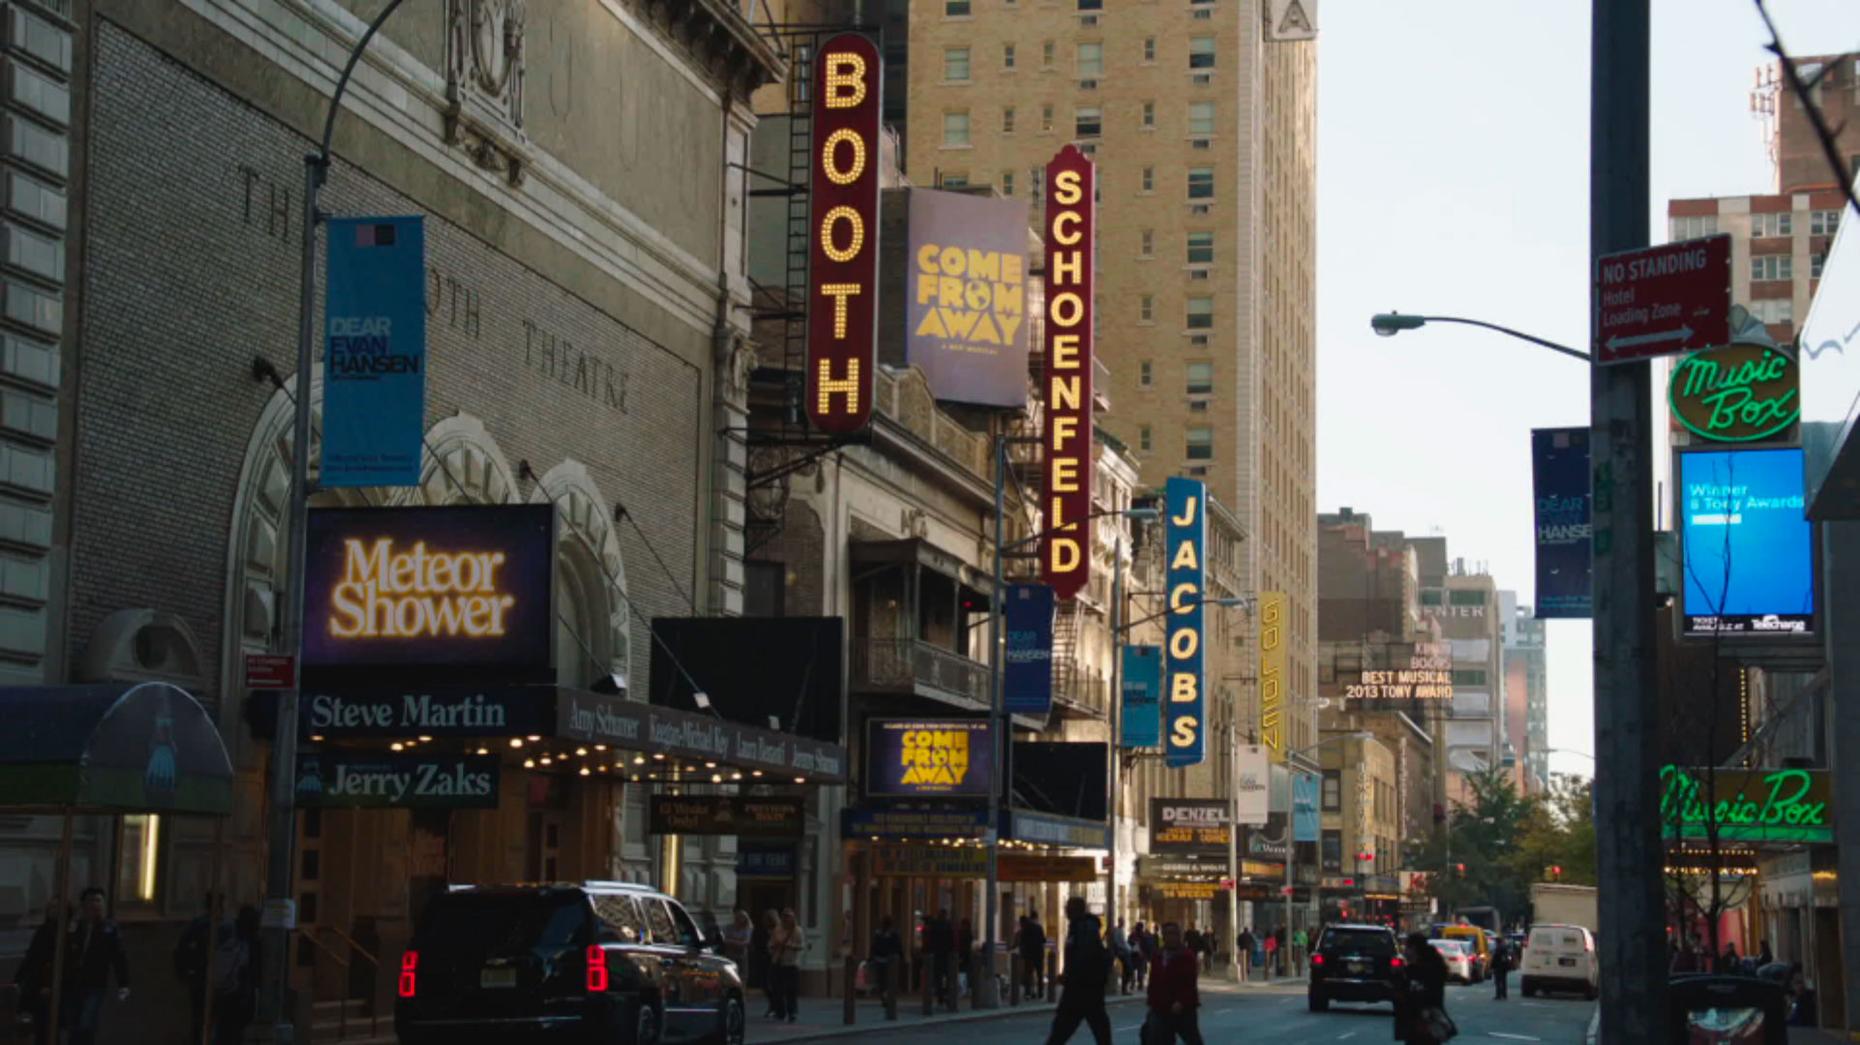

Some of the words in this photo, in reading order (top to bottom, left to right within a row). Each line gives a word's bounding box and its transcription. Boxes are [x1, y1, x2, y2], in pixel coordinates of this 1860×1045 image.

[818, 52, 867, 415] BOOTH
[917, 243, 1022, 282] COME
[1602, 263, 1625, 284] NO
[1629, 248, 1707, 280] STANDING
[917, 275, 1023, 315] FROM
[1603, 287, 1635, 307] Hotel
[330, 316, 391, 336] DEAR
[914, 305, 1022, 346] AWAY
[1602, 306, 1649, 328] Loading
[1650, 302, 1682, 321] Zone
[330, 336, 388, 355] EVAN
[330, 354, 419, 375] HANSEN
[1049, 169, 1085, 573] SCHOENFELD
[1683, 350, 1788, 397] Music
[1701, 387, 1796, 430] Box
[1537, 497, 1584, 512] DEAR
[1690, 484, 1748, 497] Winner
[1703, 498, 1740, 513] Tony
[1747, 496, 1805, 510] Awards
[1538, 524, 1592, 541] HANSE
[345, 538, 505, 594] Meteor
[330, 578, 515, 637] Shower
[1170, 496, 1199, 748] JACOBS
[1262, 599, 1280, 751] GOLDEN
[1361, 671, 1396, 685] BEST
[1399, 671, 1453, 685] MUSICAL
[1346, 685, 1379, 699] 2013
[1381, 685, 1413, 699] TONY
[1415, 685, 1454, 700] AWARD
[310, 695, 393, 728] Steve
[400, 694, 506, 727] Martin
[901, 730, 969, 749] COME
[901, 747, 969, 766] FROM
[327, 764, 411, 803] Jerry
[414, 762, 491, 796] Zaks
[900, 765, 969, 785] AWAY
[1758, 769, 1825, 824] Box
[1162, 806, 1231, 822] DENZEL
